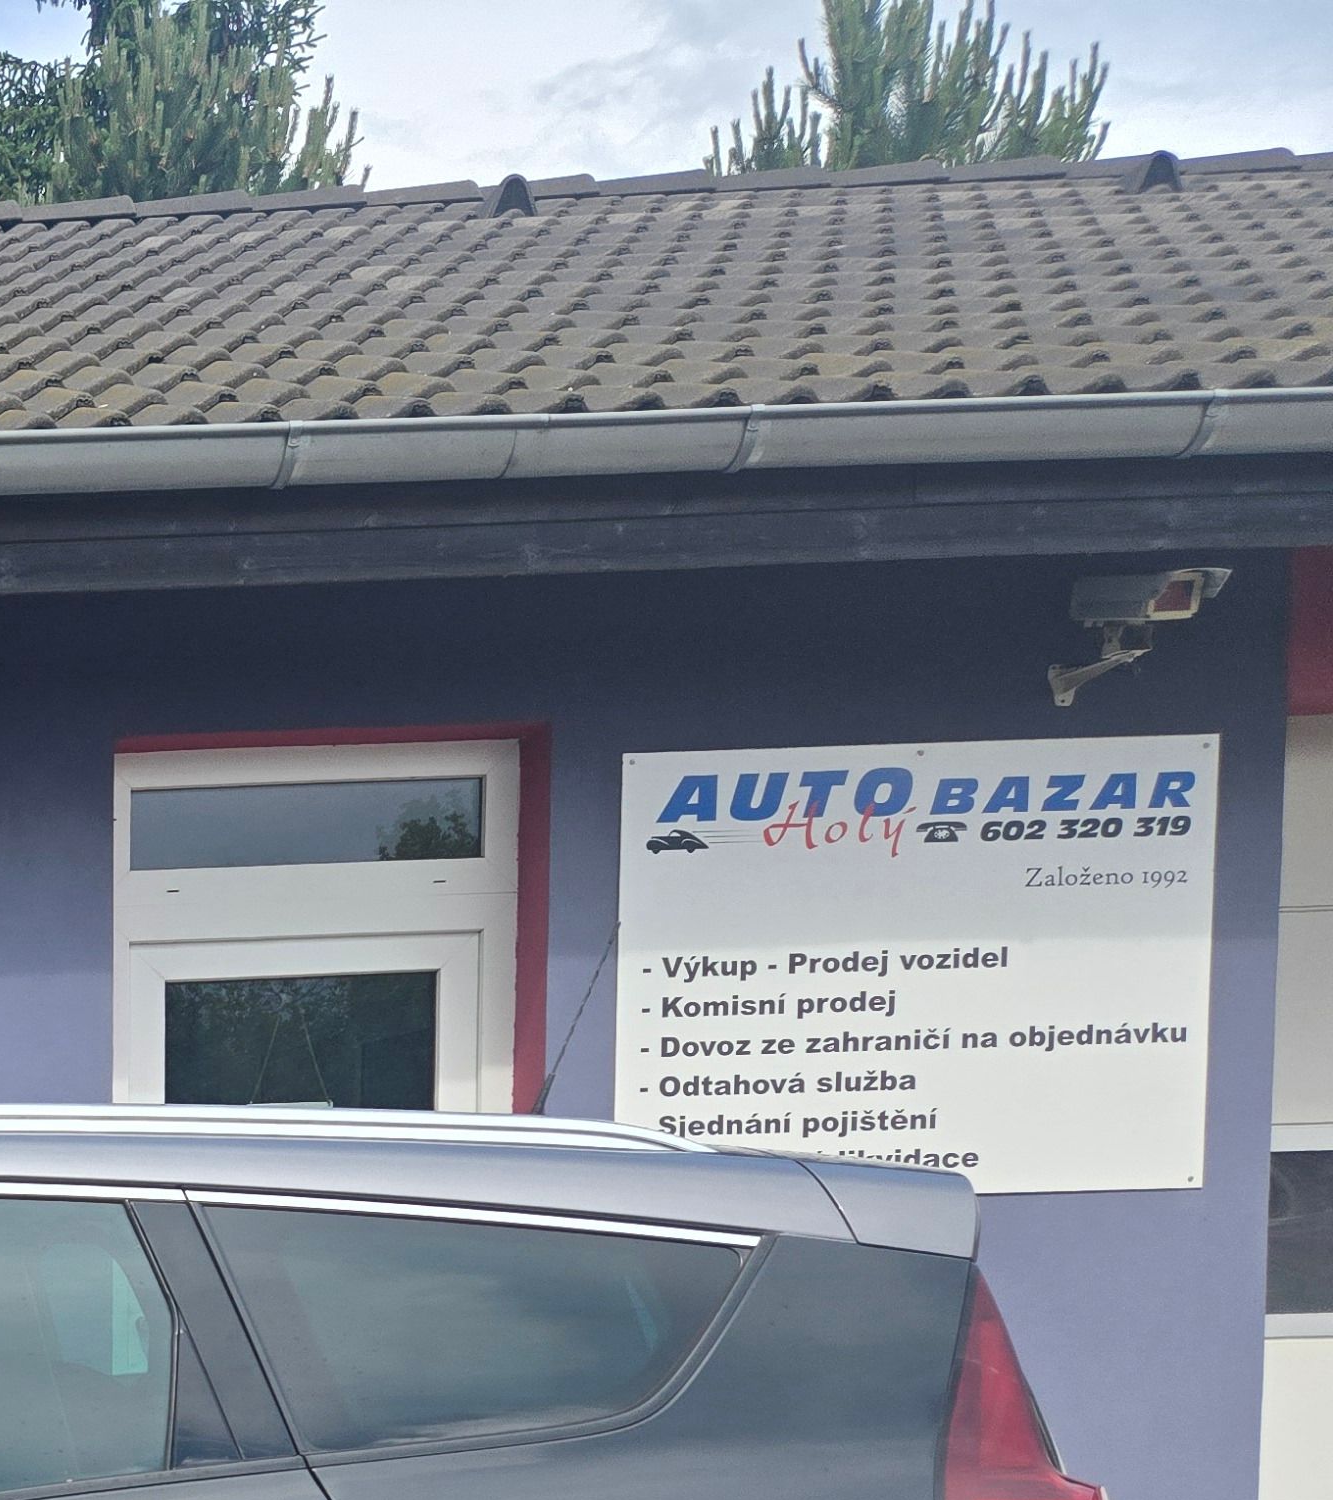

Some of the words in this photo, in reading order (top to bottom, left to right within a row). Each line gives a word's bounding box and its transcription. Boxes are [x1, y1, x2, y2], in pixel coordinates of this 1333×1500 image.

[656, 767, 915, 823] AUTO
[930, 771, 1196, 815] BAZAR
[763, 801, 917, 857] Holý
[980, 819, 1047, 842] 602
[1056, 817, 1124, 840] 320
[1132, 815, 1192, 837] 319
[1024, 865, 1134, 888] Založeno
[1142, 870, 1188, 889] 1992
[661, 955, 758, 983] Výkup
[788, 949, 889, 977] Prodej
[899, 946, 1008, 971] vozidel
[661, 992, 786, 1018] Komisní
[797, 989, 896, 1018] prodej
[660, 1036, 751, 1058] Dovoz
[760, 1038, 796, 1055] ze
[805, 1027, 951, 1054] zahraničí
[961, 1031, 998, 1049] na
[1009, 1022, 1187, 1051] objednávku
[659, 1072, 805, 1097] Odtahová
[816, 1070, 916, 1093] služba
[658, 1111, 792, 1139] Sjednání
[802, 1107, 938, 1138] pojištění
